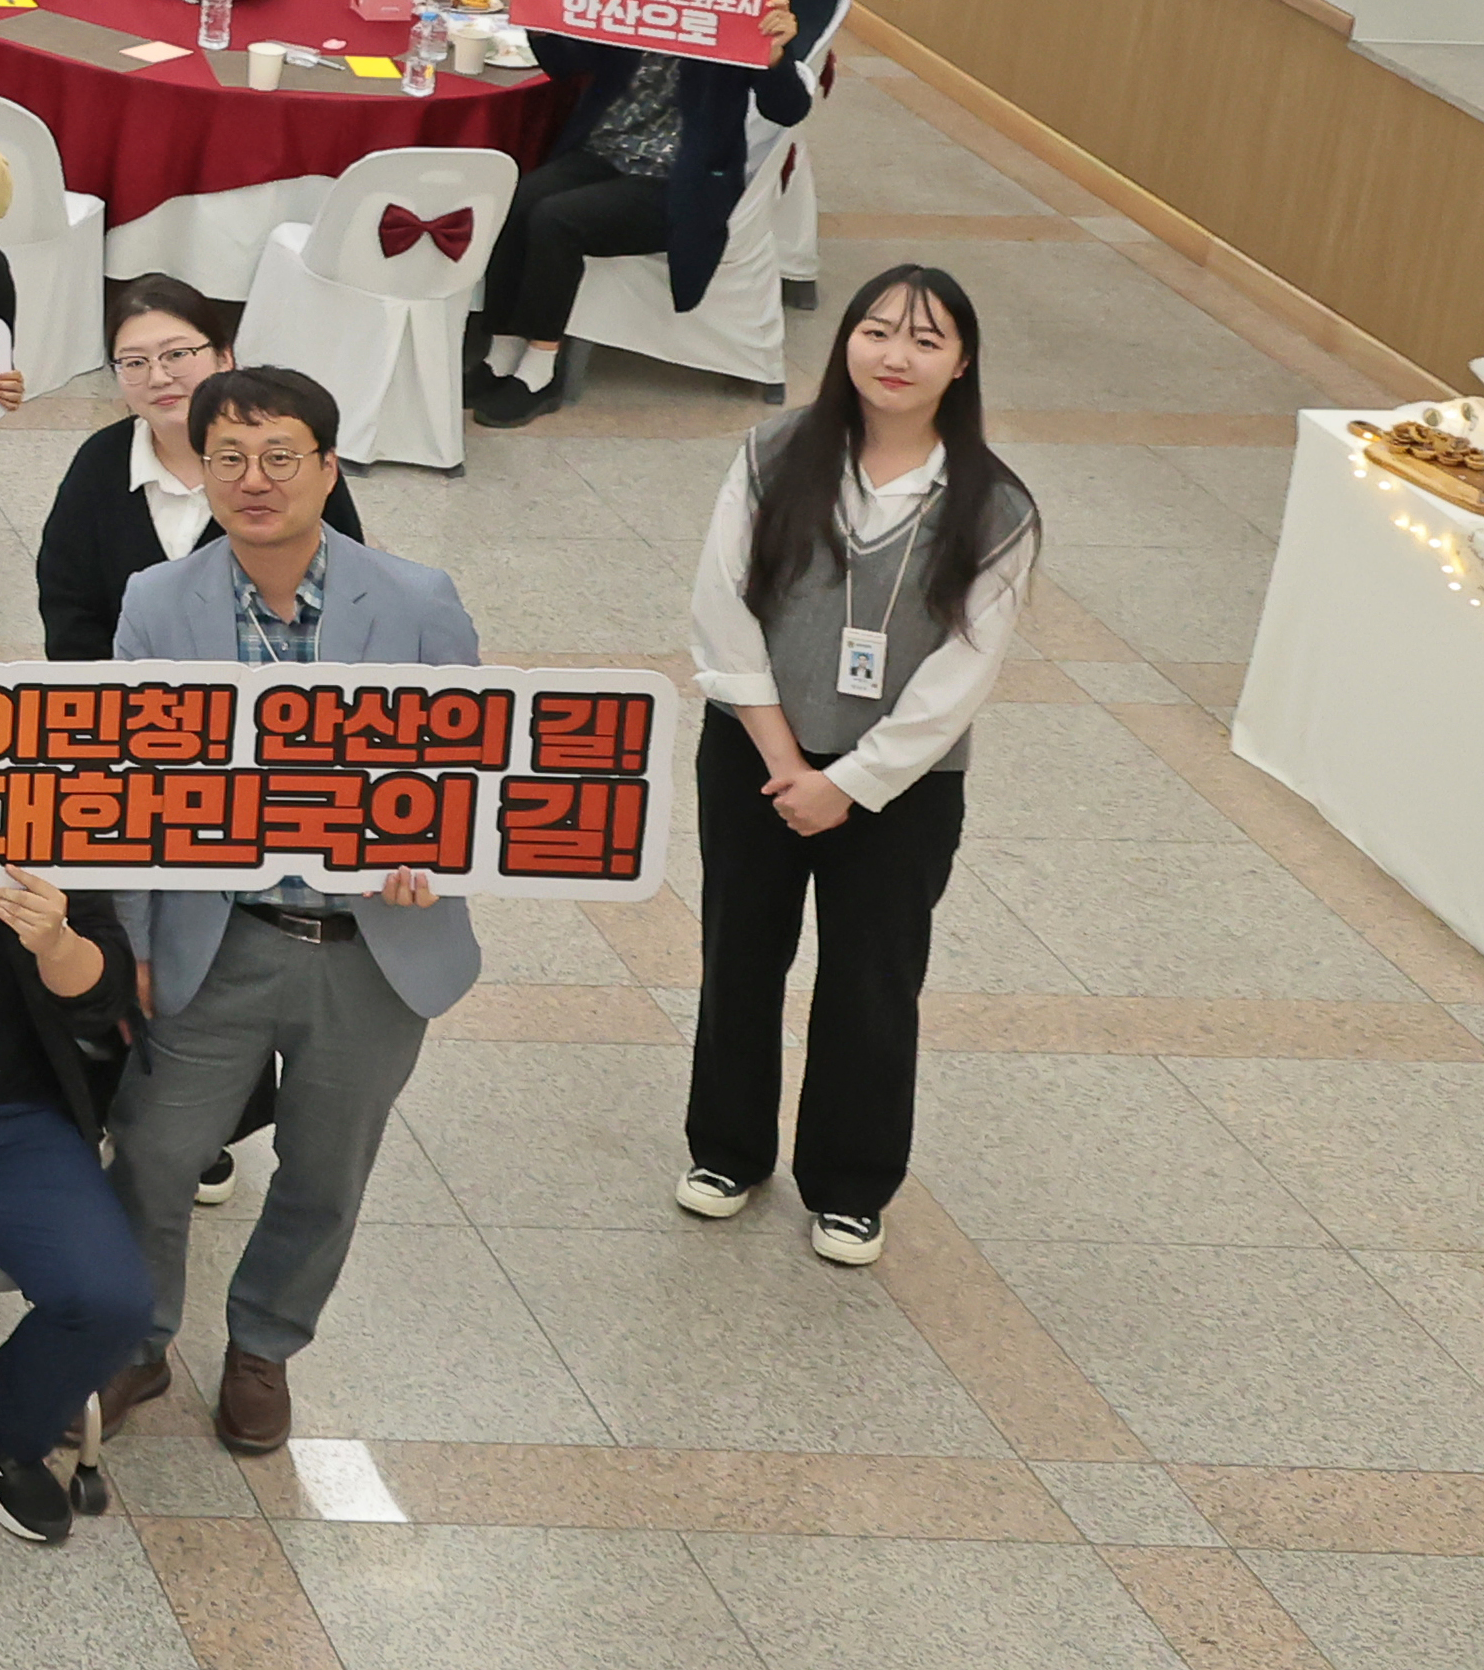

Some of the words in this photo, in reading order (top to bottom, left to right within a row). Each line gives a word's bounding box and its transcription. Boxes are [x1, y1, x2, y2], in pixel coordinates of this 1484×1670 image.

[259, 691, 511, 767] 안산의
[536, 696, 648, 772] 길!
[502, 779, 648, 878] 길!
